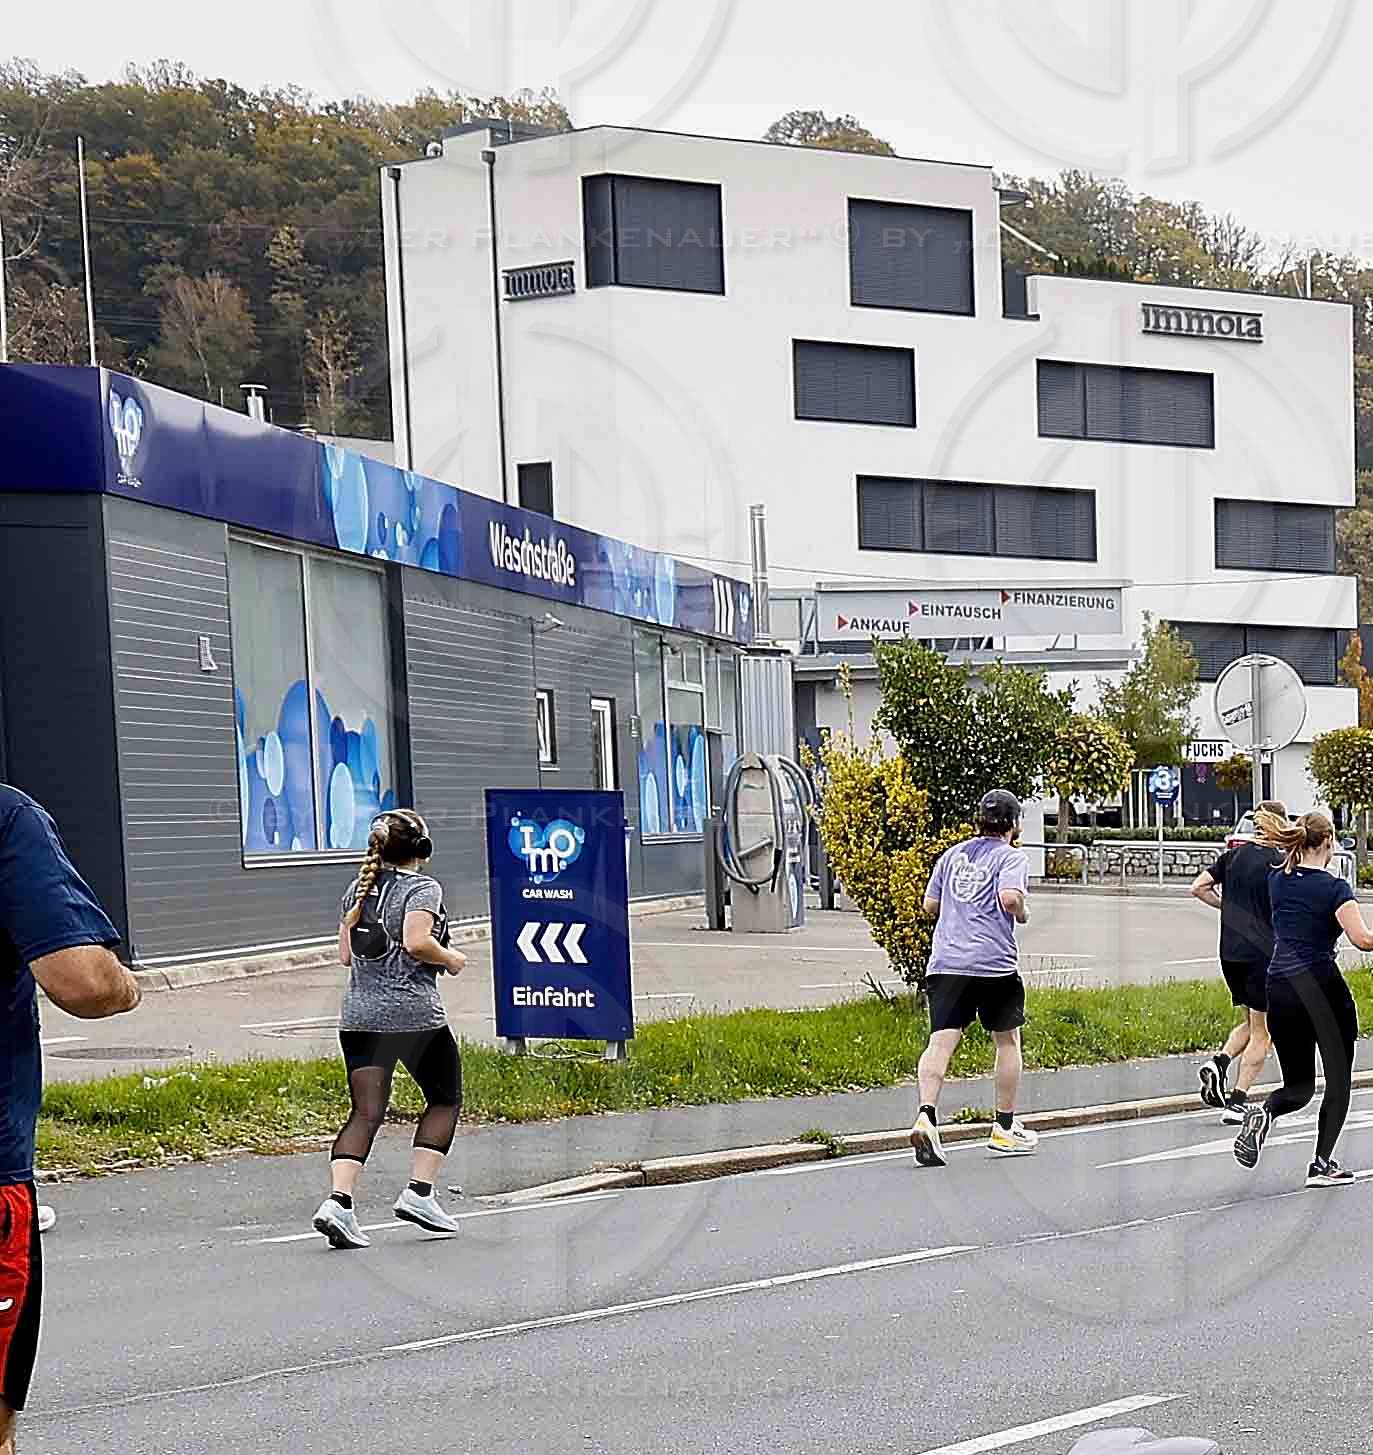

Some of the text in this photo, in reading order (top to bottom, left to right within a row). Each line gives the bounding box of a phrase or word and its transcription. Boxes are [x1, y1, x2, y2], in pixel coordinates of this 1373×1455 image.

[489, 520, 575, 586] Waschstraße
[1013, 592, 1115, 610] FINANZIERUNG
[921, 603, 1001, 620] EINTAUSCH
[850, 618, 911, 633] ANKAUF
[1186, 743, 1224, 758] FUCHS
[523, 889, 573, 899] CAR WASH
[513, 987, 595, 1007] Einfahrt
